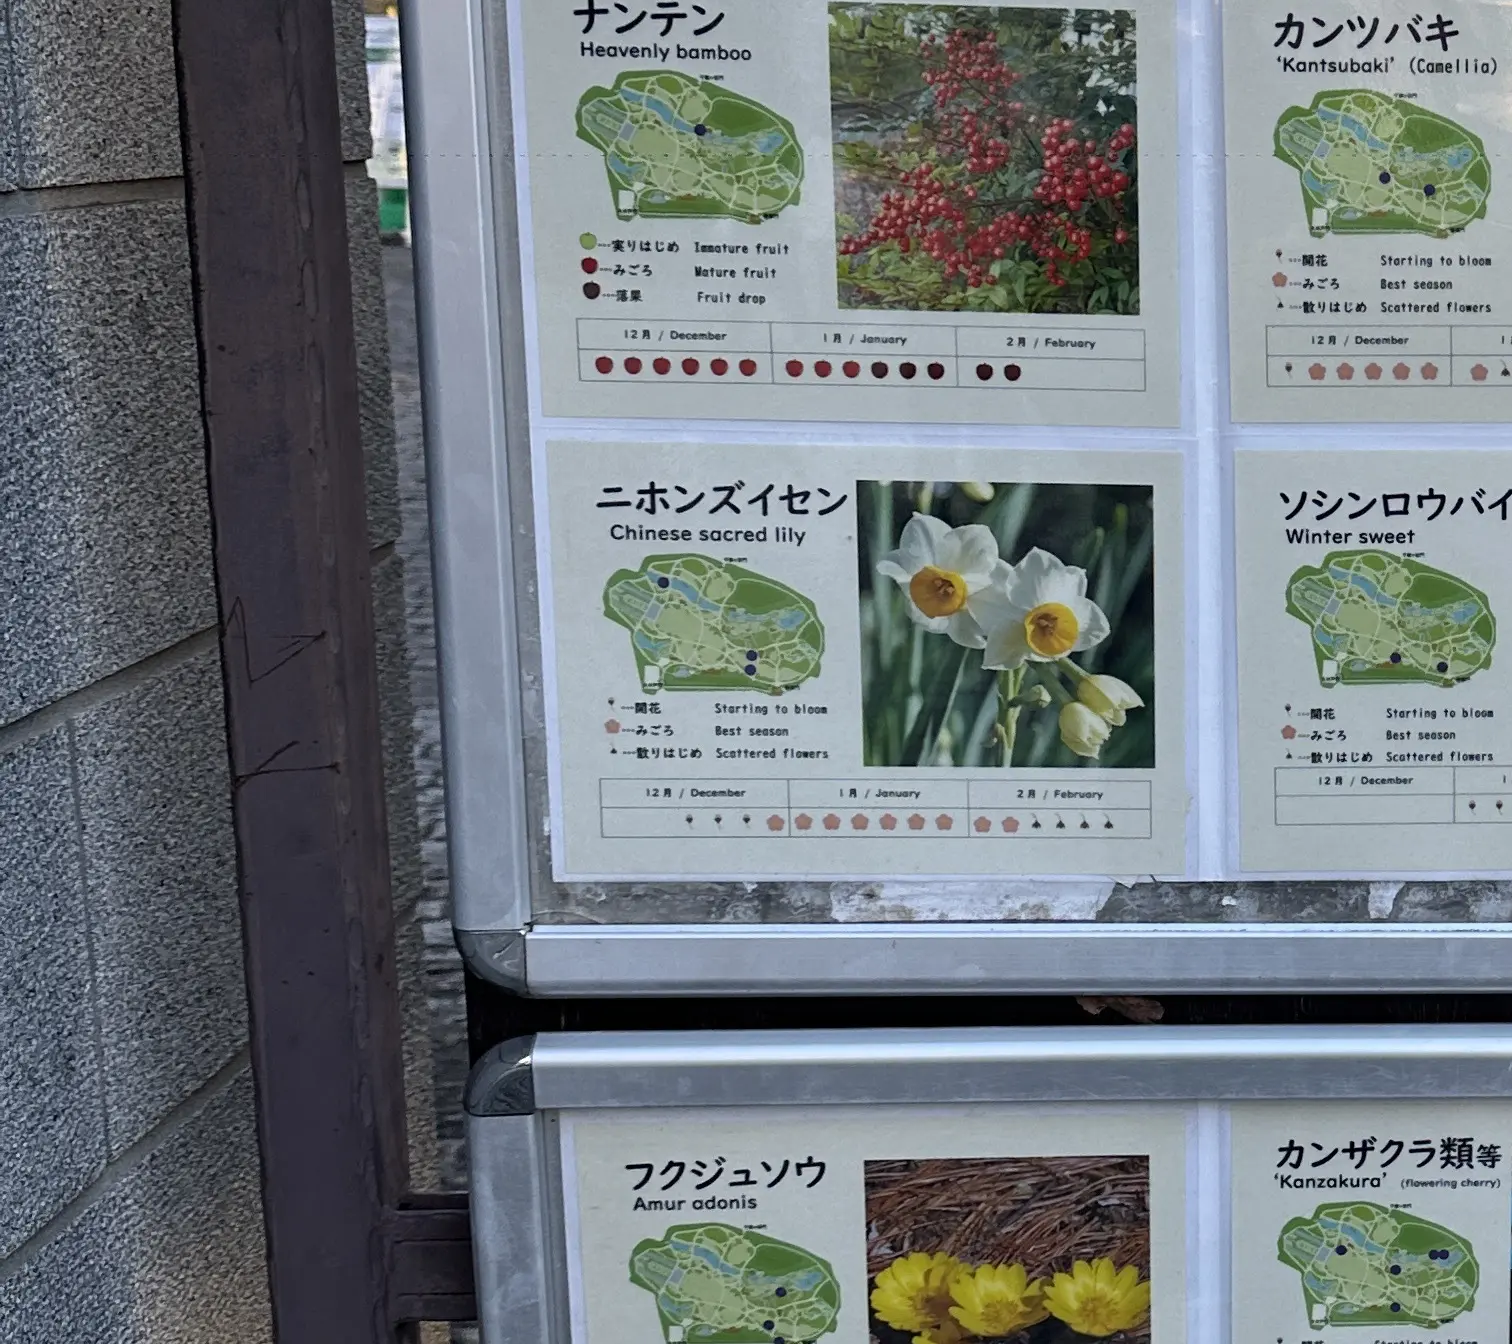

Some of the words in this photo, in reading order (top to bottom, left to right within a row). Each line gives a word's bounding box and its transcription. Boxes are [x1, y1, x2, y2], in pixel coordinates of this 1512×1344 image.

[1273, 12, 1460, 52] カンツバキ
[580, 41, 670, 63] Heavenly
[676, 43, 752, 61] bamboo
[1409, 56, 1498, 76] (Camellia)
[755, 243, 789, 255] fruit
[1380, 254, 1433, 268] Starting
[1440, 255, 1453, 267] to
[1458, 255, 1492, 267] bloom
[694, 265, 737, 279] Mature
[743, 266, 777, 279] fruit
[1380, 278, 1407, 290] Best
[1413, 280, 1453, 290] season
[697, 291, 732, 304] Fruit
[738, 291, 766, 306] drop
[1380, 301, 1440, 313] Scattered
[1446, 301, 1492, 313] flowers
[669, 330, 728, 341] December
[859, 333, 908, 347] January
[1044, 337, 1097, 351] February
[595, 479, 848, 517] ニホンズイセン
[610, 523, 692, 542] Chinese
[699, 526, 768, 543] sacred
[775, 526, 807, 547] lily
[1285, 528, 1353, 545] Winter
[1358, 529, 1416, 545] sweet
[1386, 707, 1437, 720] Starting
[1443, 708, 1456, 719] to
[1462, 707, 1494, 719] bloom
[1385, 729, 1412, 741] Best
[1418, 731, 1456, 741] season
[1385, 751, 1443, 763] Scattered
[1450, 750, 1494, 762] flowers
[1360, 775, 1414, 786] December
[690, 788, 747, 798] December
[875, 788, 921, 800] January
[1053, 789, 1104, 801] February
[1276, 1135, 1503, 1174] カンザクラ類等
[624, 1155, 826, 1191] フクジュソウ
[1400, 1178, 1458, 1190] (flowering
[1460, 1178, 1501, 1189] cherry)
[632, 1196, 687, 1212] Amur
[691, 1194, 758, 1211] adonis
